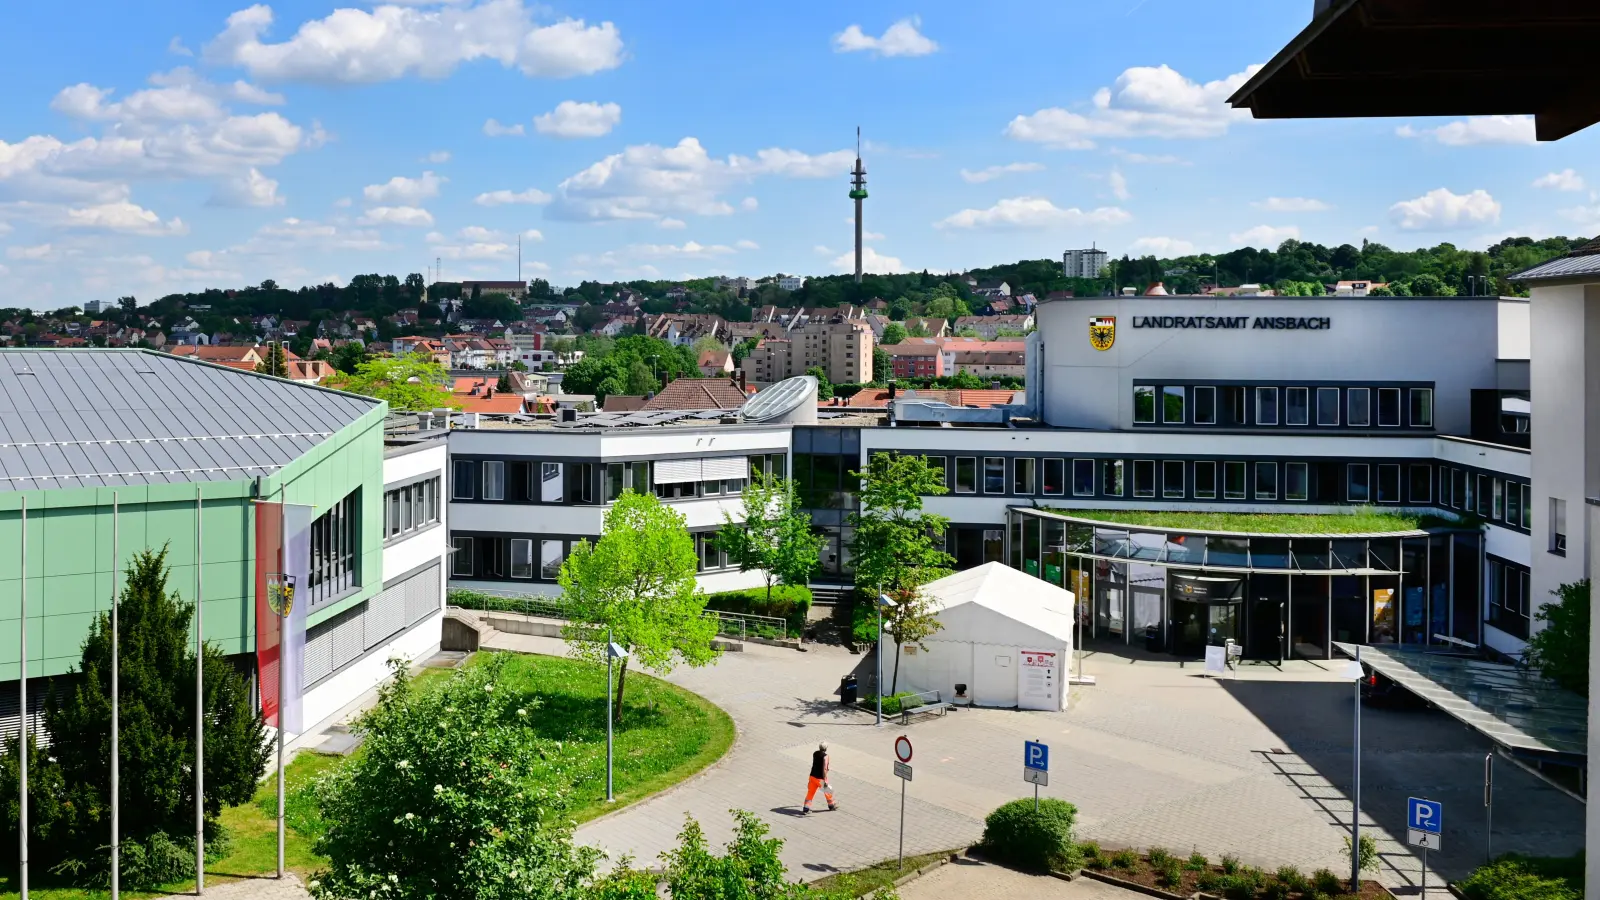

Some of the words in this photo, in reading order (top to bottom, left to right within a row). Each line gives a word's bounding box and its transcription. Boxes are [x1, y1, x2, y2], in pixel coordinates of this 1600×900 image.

[1132, 316, 1249, 329] LANDRATSAMT
[1252, 317, 1331, 330] ANSBACH
[1030, 745, 1043, 765] P
[1416, 803, 1433, 825] P
